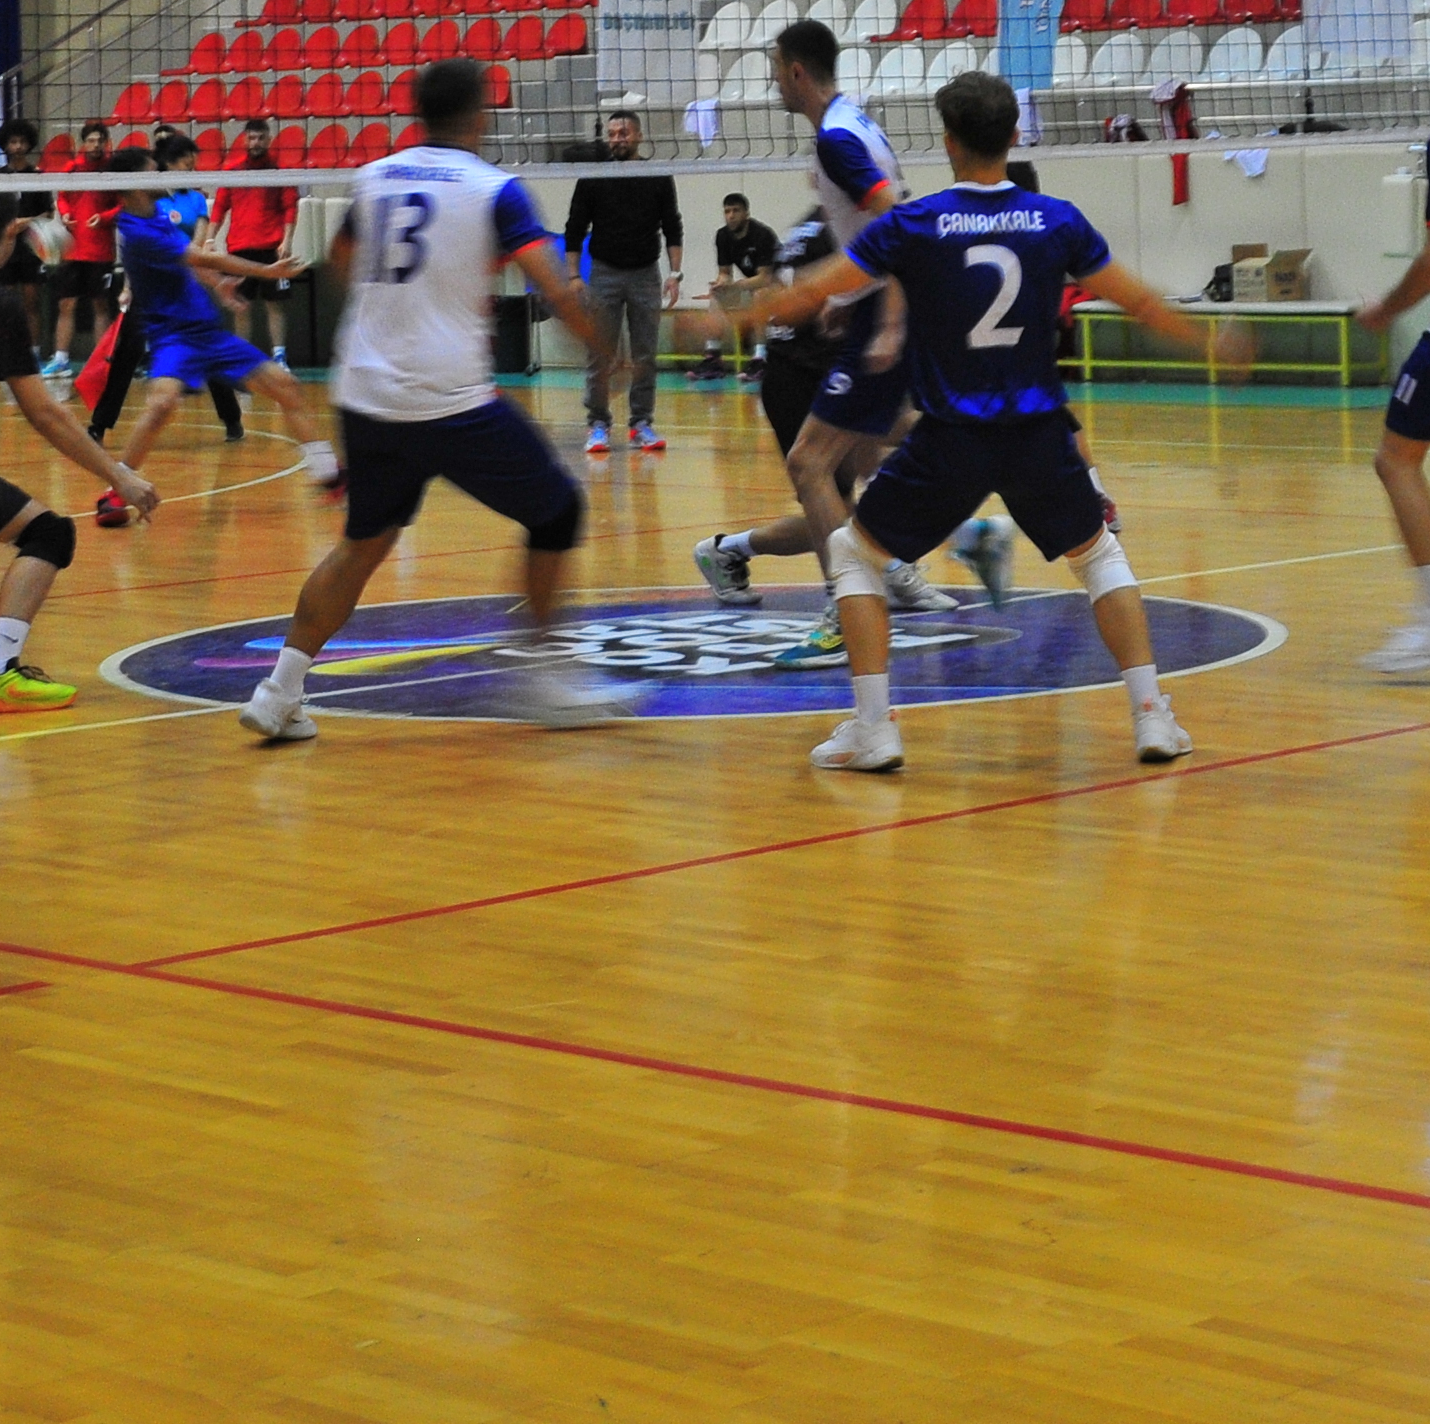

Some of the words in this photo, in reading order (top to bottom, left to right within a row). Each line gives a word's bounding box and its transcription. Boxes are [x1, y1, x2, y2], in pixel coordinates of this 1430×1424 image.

[368, 192, 437, 284] 13
[938, 210, 1047, 239] ÇANAKKALE
[963, 243, 1025, 350] 2
